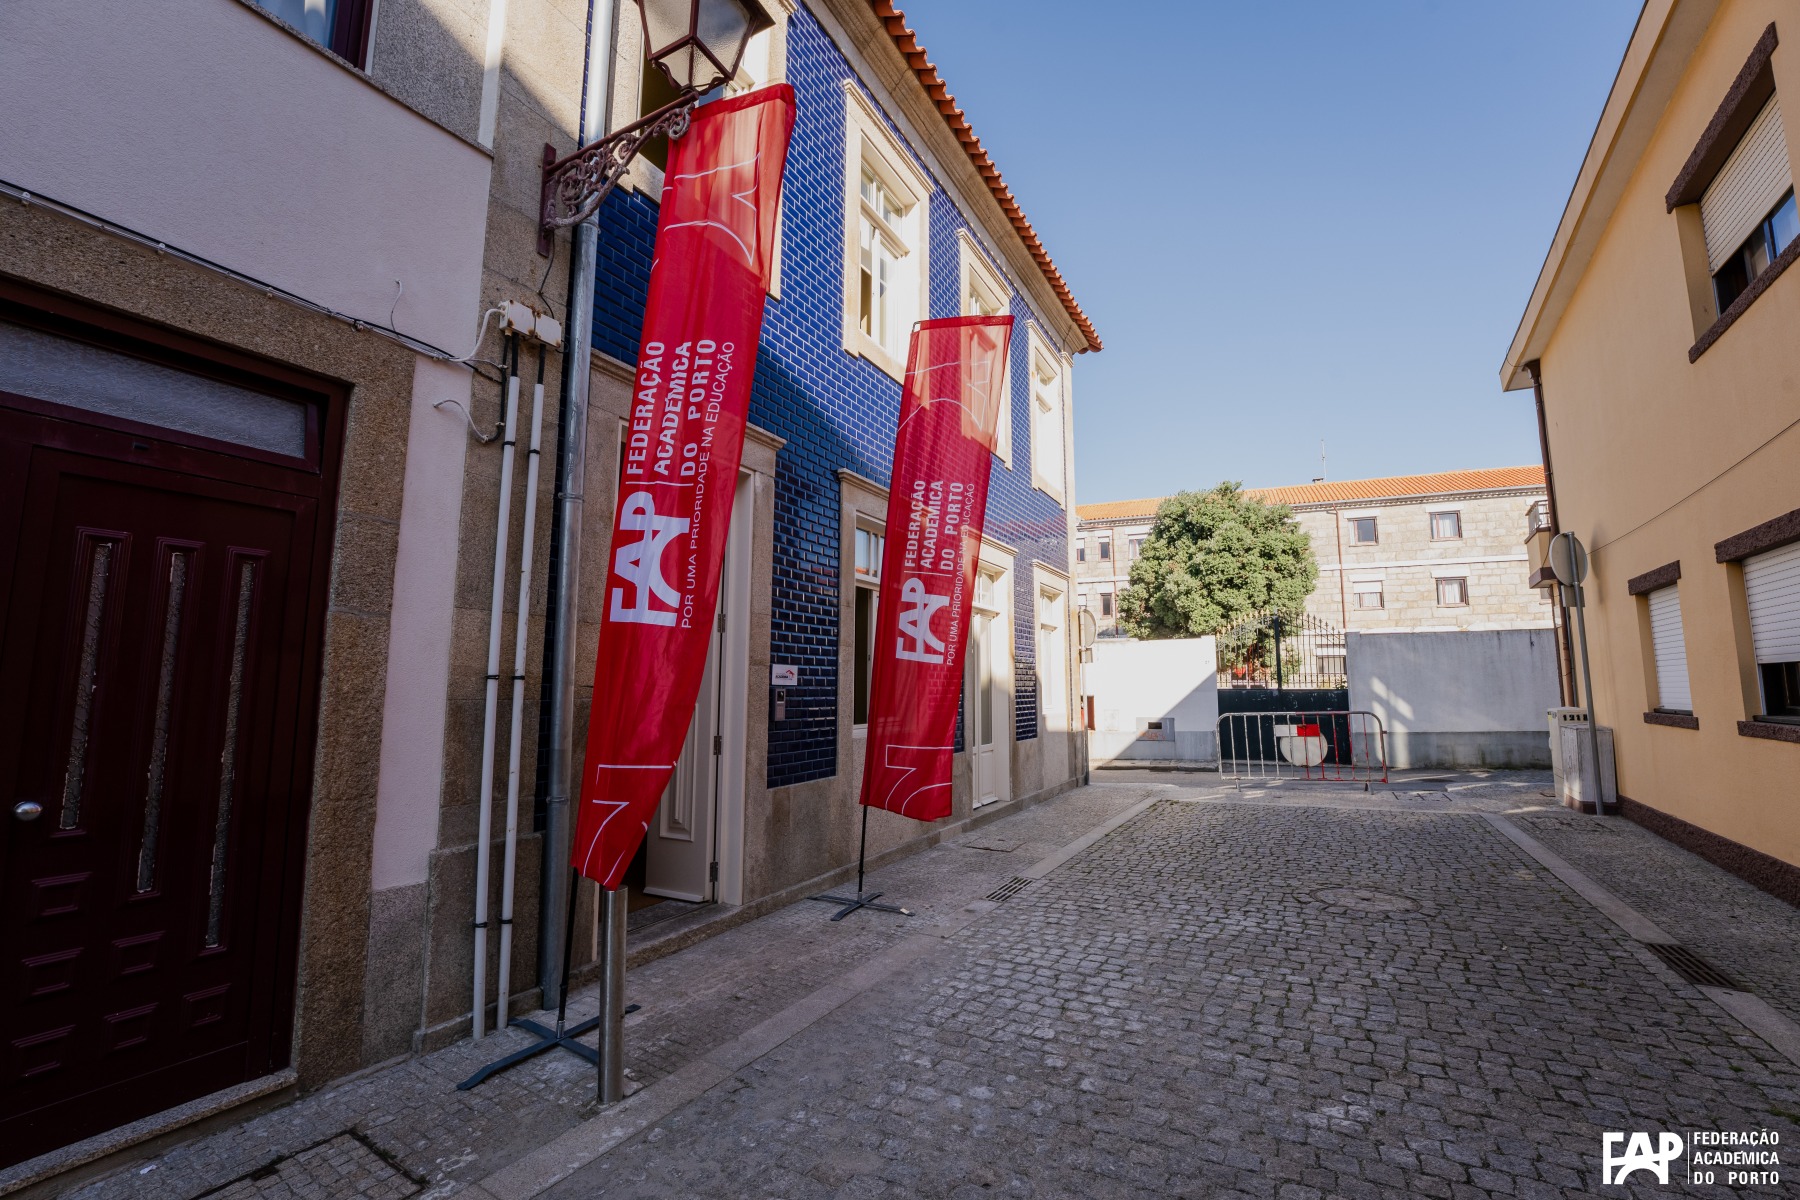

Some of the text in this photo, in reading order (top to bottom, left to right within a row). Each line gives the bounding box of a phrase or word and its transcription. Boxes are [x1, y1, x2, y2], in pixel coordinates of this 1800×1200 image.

[626, 342, 665, 475] FEDERAÇÃO
[654, 342, 692, 476] ACADÉMICA
[680, 339, 716, 476] DO PORTO
[681, 342, 735, 629] POR UMA PRIORIDADE NA EDUCAÇÃO
[904, 480, 926, 567] FEDERAÇÃO
[939, 482, 964, 571] DO PORTO
[610, 491, 690, 627] FAP
[896, 578, 950, 664] FAP
[947, 484, 975, 666] POR UMA PRIORIDADE NA EDUCAÇÃO
